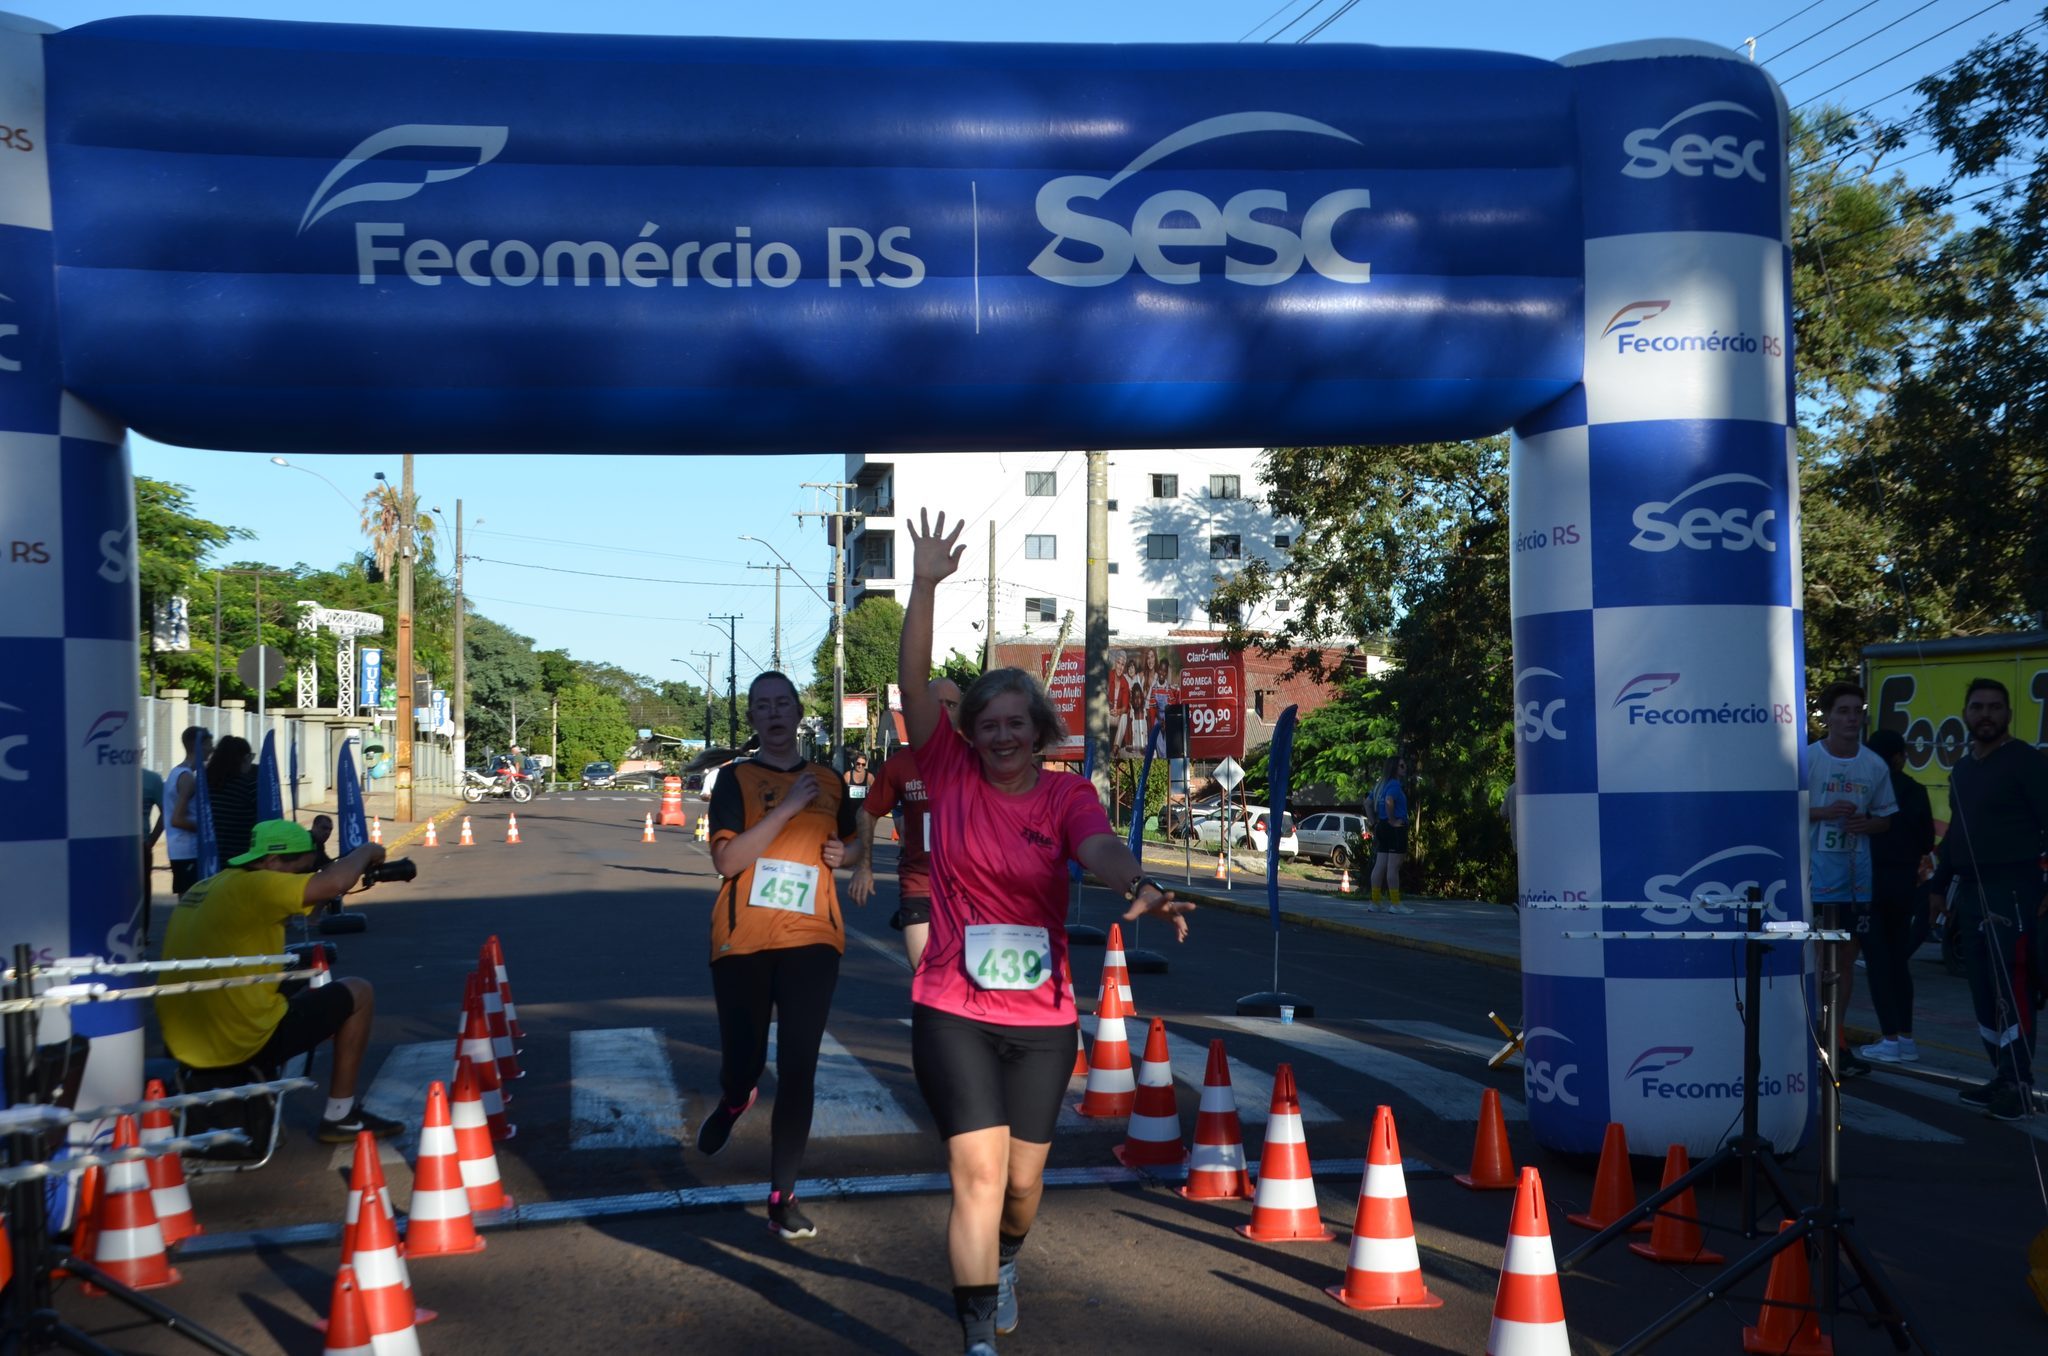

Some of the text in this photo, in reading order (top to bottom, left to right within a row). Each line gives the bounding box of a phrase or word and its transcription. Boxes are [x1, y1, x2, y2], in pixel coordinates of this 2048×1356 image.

[1621, 127, 1766, 184] Sesc
[1027, 174, 1371, 288] Sesc
[355, 220, 926, 288] Fecomércio RS
[1618, 330, 1782, 358] Fecomércio RS
[1552, 524, 1580, 546] RS
[1629, 500, 1776, 553] Sesc
[10, 540, 51, 564] RS
[366, 667, 379, 703] URI
[1049, 686, 1082, 699] laro Multi
[1182, 676, 1212, 687] 600 MEGA
[1217, 675, 1227, 685] 60
[1217, 686, 1233, 695] GIGA
[1192, 707, 1231, 734] 99,90
[1629, 702, 1793, 725] Fecomércio RS
[760, 877, 809, 908] 457
[978, 948, 1042, 984] 439
[1642, 1073, 1806, 1099] Fecomécio RS
